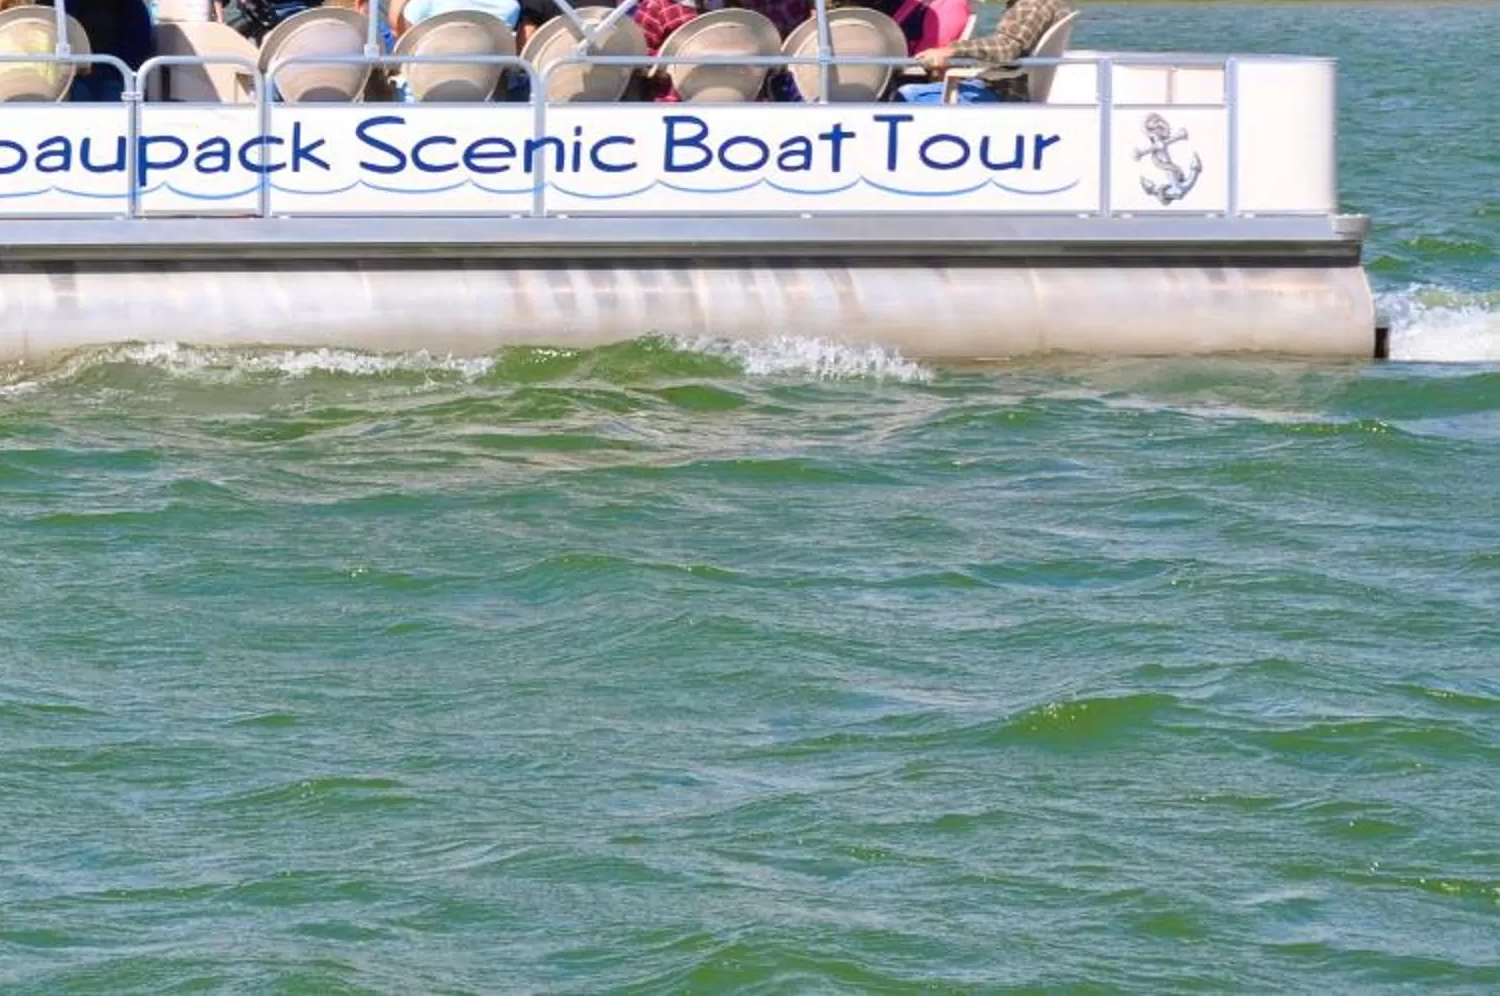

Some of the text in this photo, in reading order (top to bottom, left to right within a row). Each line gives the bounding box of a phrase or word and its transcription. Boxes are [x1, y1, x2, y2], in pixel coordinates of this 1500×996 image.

[355, 115, 638, 175] Scenic
[662, 114, 857, 173] Boat
[872, 113, 1061, 172] Tour
